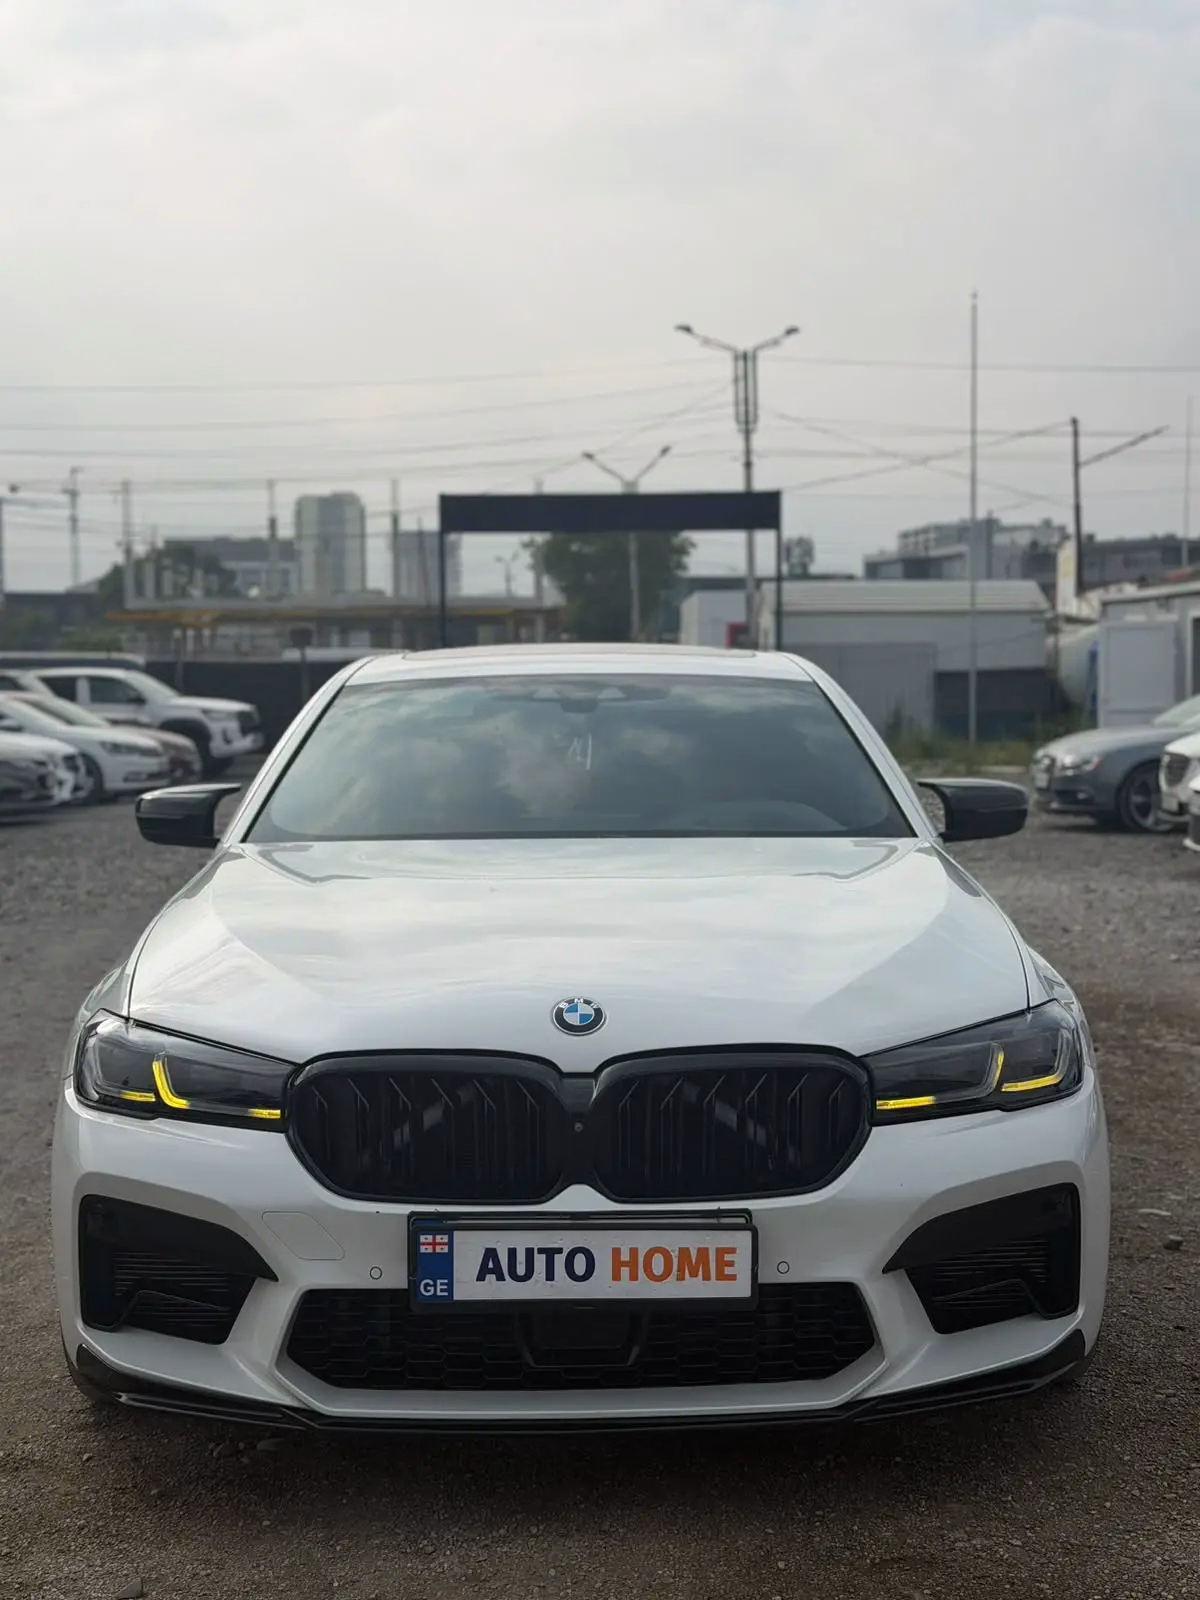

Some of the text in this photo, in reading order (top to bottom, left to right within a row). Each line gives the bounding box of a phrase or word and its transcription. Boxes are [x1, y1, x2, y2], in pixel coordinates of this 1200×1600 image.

[559, 998, 600, 1008] BMW
[475, 1246, 738, 1283] AUTO HOME
[420, 1279, 448, 1296] GE
